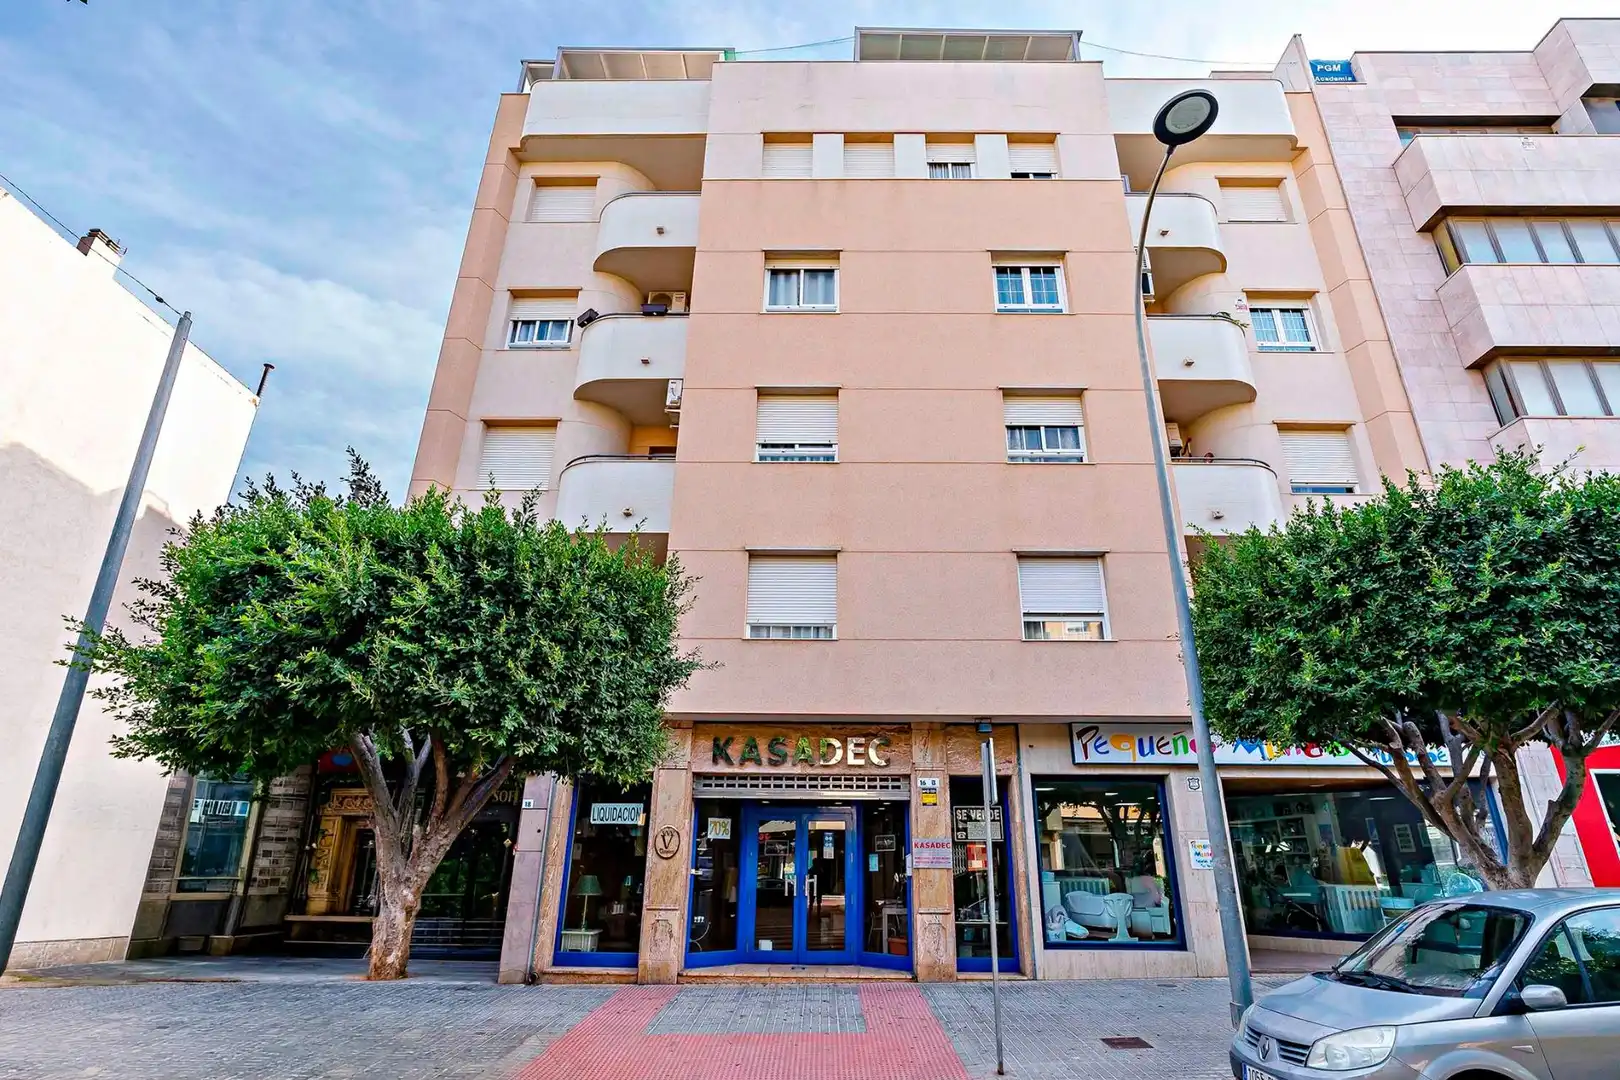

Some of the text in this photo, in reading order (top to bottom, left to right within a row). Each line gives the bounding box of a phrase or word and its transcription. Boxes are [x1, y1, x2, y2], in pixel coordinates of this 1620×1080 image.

[1317, 64, 1341, 72] PGM
[712, 736, 891, 767] KASADEC
[592, 806, 642, 822] LIQUIDACION
[956, 809, 1000, 820] SE VEDE
[709, 820, 730, 836] 70%
